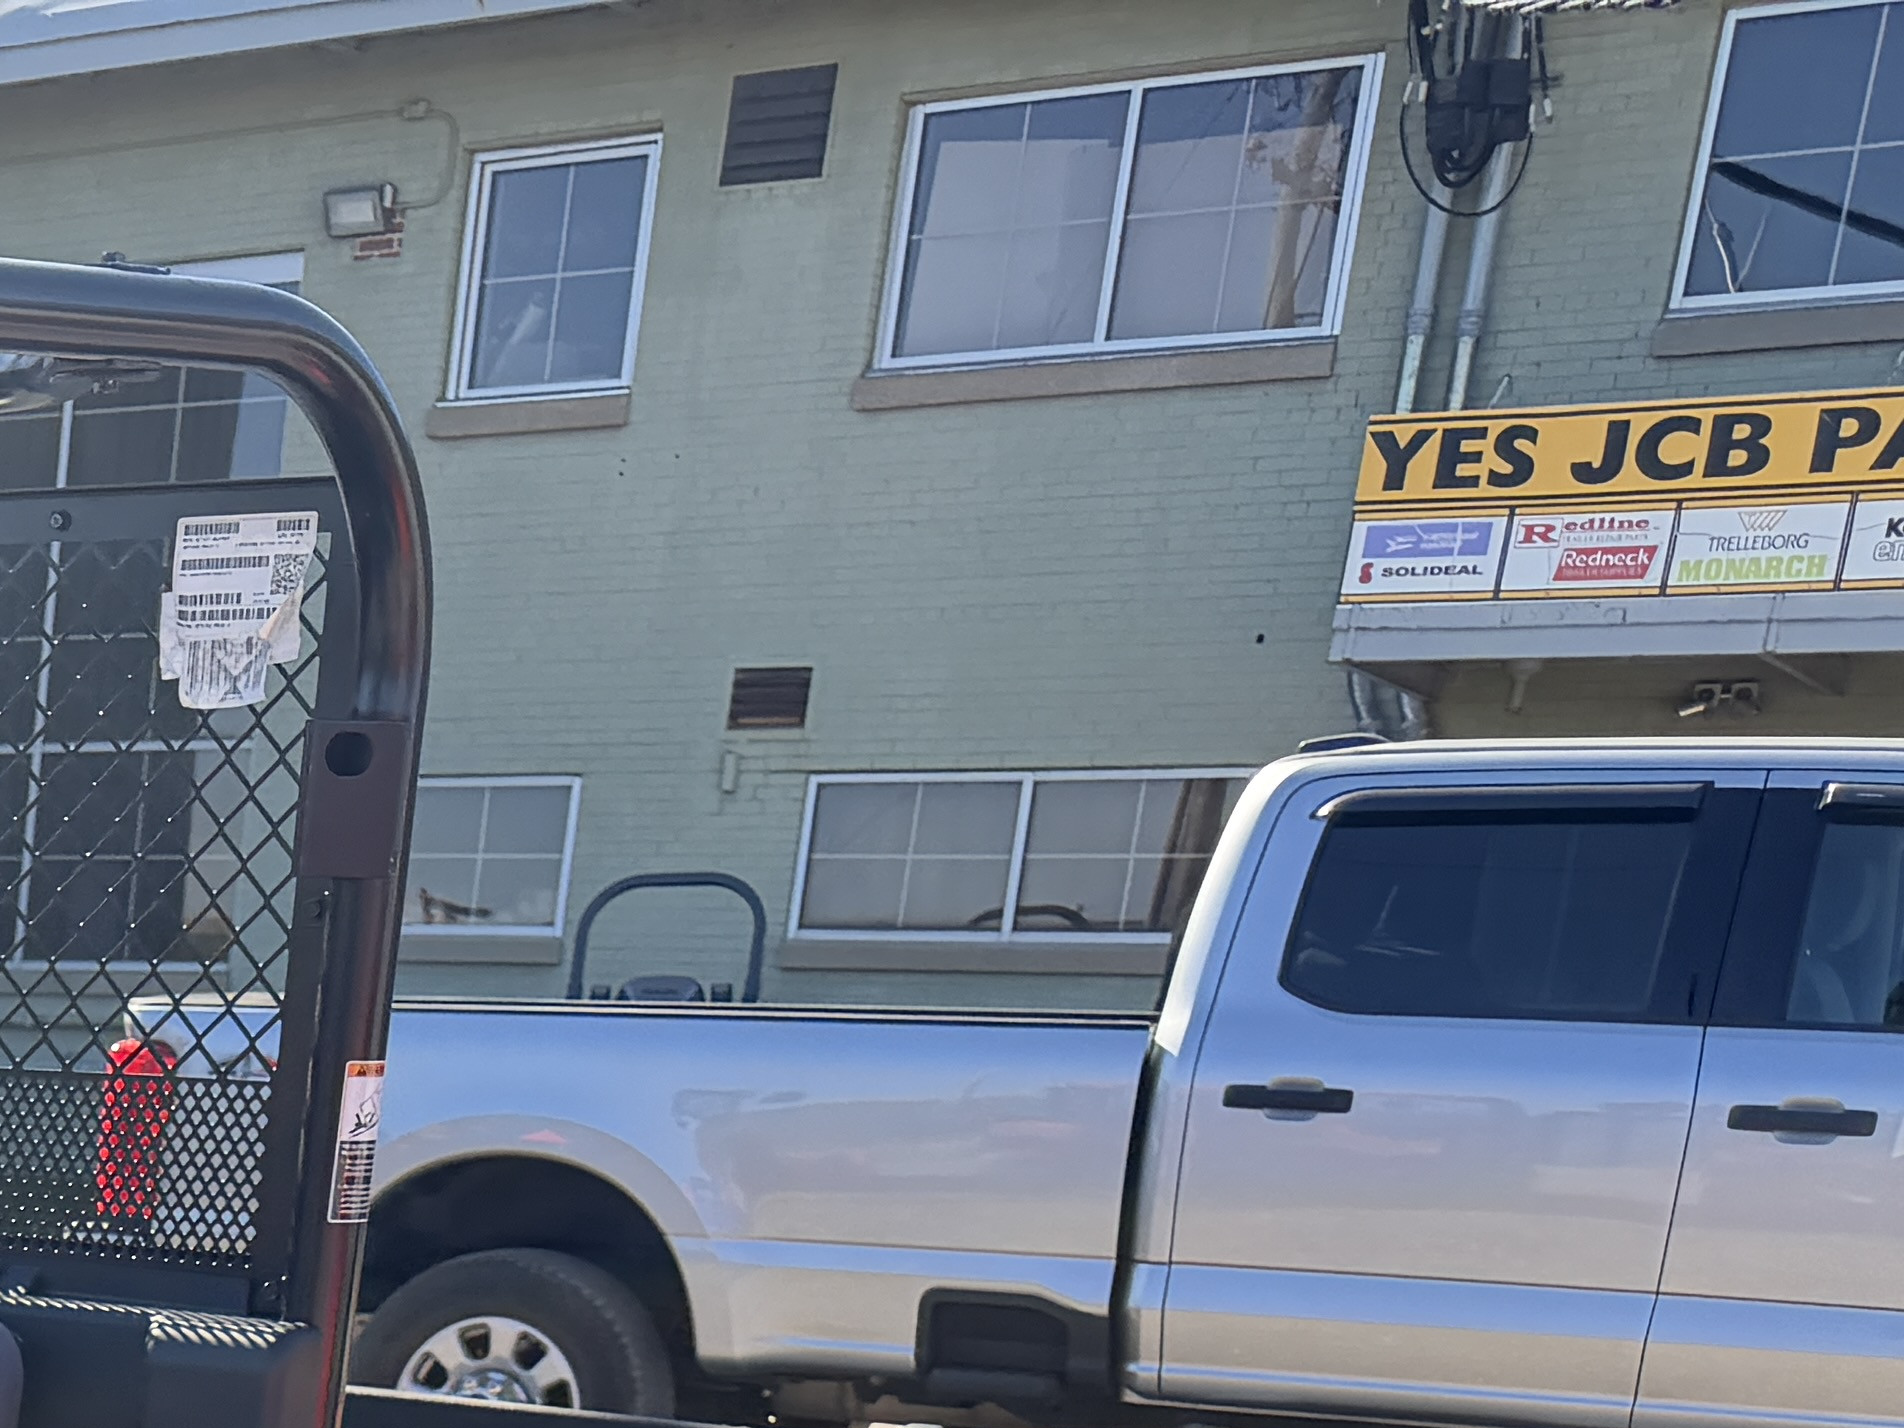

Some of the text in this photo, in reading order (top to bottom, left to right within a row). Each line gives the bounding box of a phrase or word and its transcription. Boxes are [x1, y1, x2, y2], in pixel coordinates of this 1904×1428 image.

[1370, 424, 1539, 491] YES
[1570, 411, 1773, 485] JCB
[1884, 517, 1904, 539] K
[1708, 532, 1810, 552] TRELLEBORG
[1561, 547, 1651, 568] Redneck
[1676, 553, 1829, 583] MONARCH
[1381, 564, 1483, 578] SOLIDEAL
